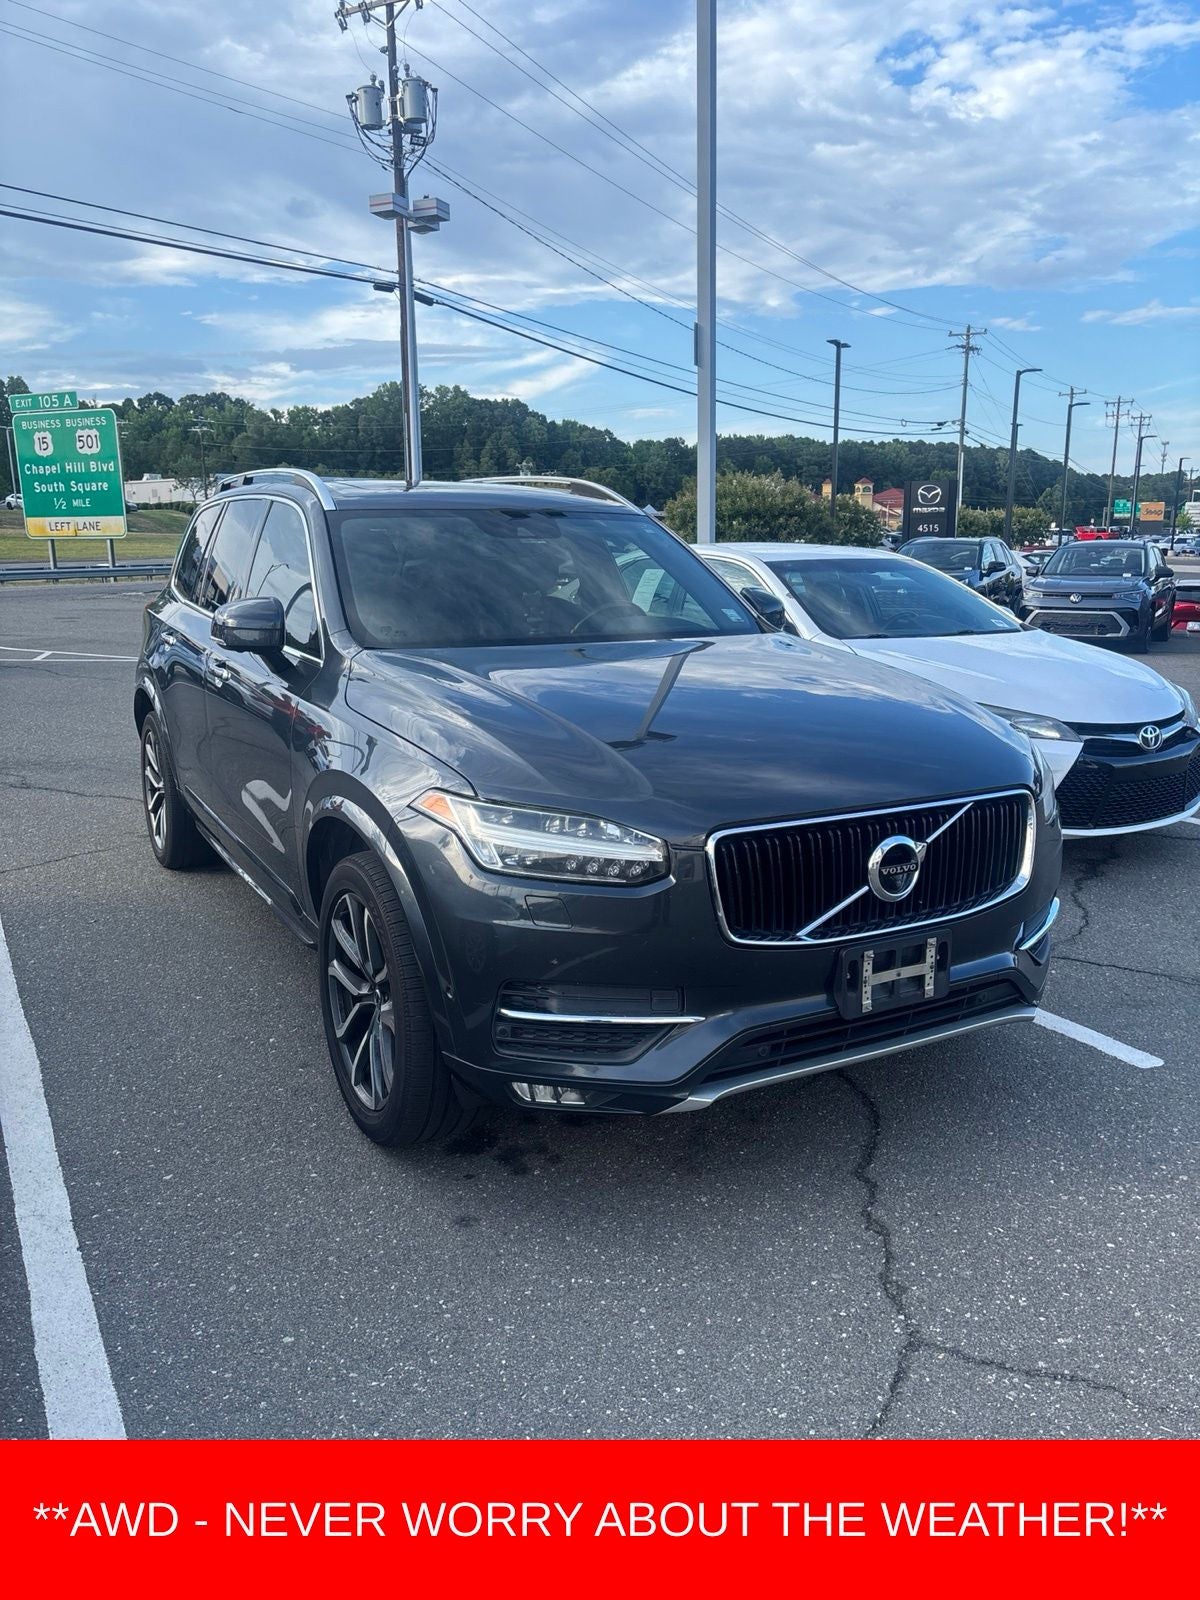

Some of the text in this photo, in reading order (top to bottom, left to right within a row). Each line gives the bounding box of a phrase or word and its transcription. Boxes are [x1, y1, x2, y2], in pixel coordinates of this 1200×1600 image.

[15, 394, 73, 408] EXIT 105 A
[21, 416, 107, 430] BUSINESS BUSINESS
[37, 436, 49, 451] 15
[77, 434, 99, 450] 501
[24, 461, 115, 476] Chapel Hill Blvd
[33, 480, 109, 494] South Square
[72, 498, 91, 507] MILE
[48, 521, 102, 532] LEFT LANE
[917, 523, 940, 533] 4515
[881, 864, 916, 875] VOLVO
